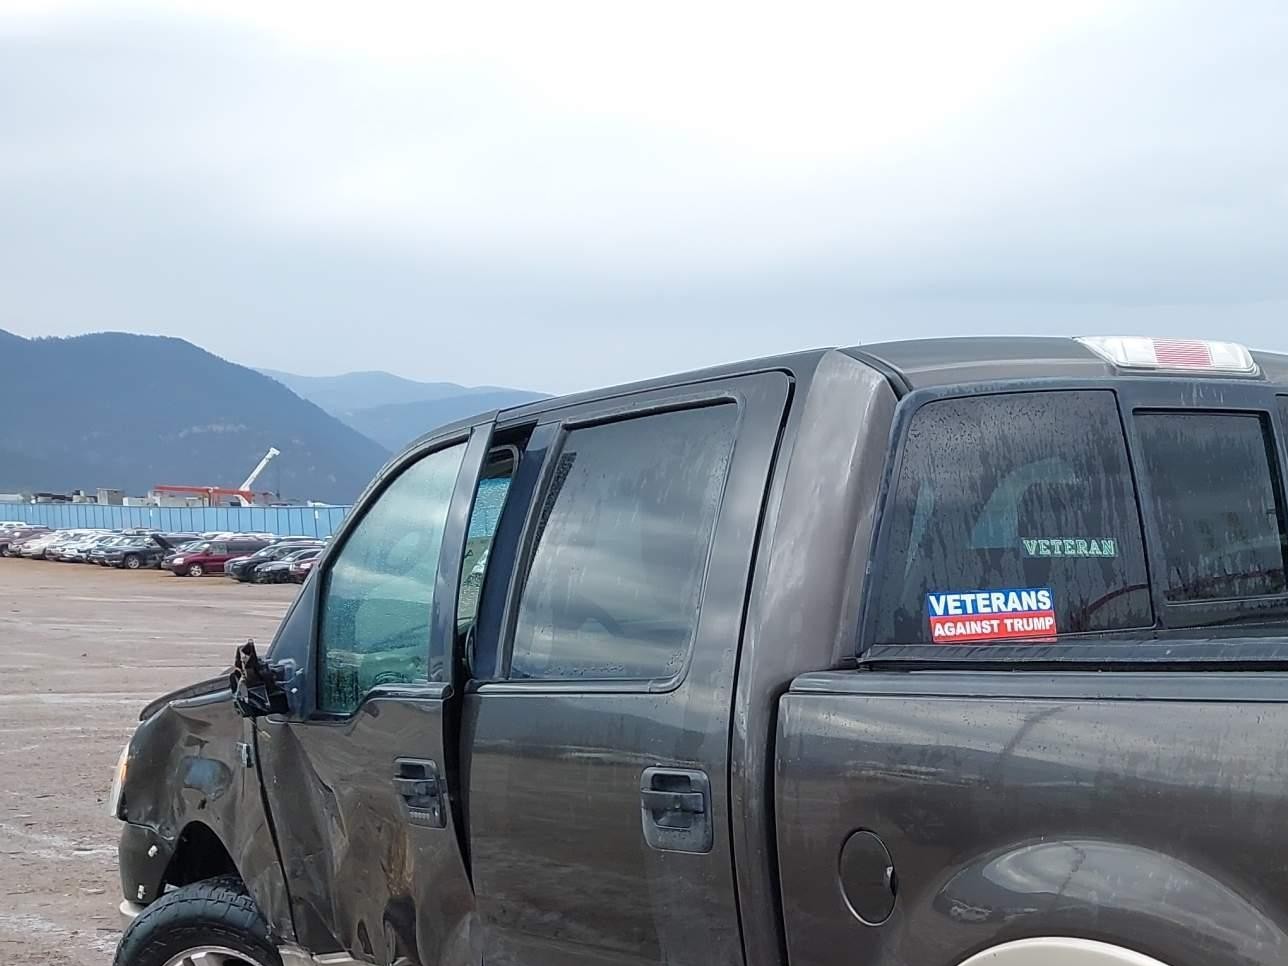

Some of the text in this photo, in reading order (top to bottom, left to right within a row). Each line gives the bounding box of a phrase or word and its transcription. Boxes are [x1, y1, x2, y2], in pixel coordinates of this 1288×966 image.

[1022, 538, 1116, 556] VETERAN
[929, 590, 1051, 616] VETERANS
[934, 616, 1054, 637] AGAINST TRUMP
